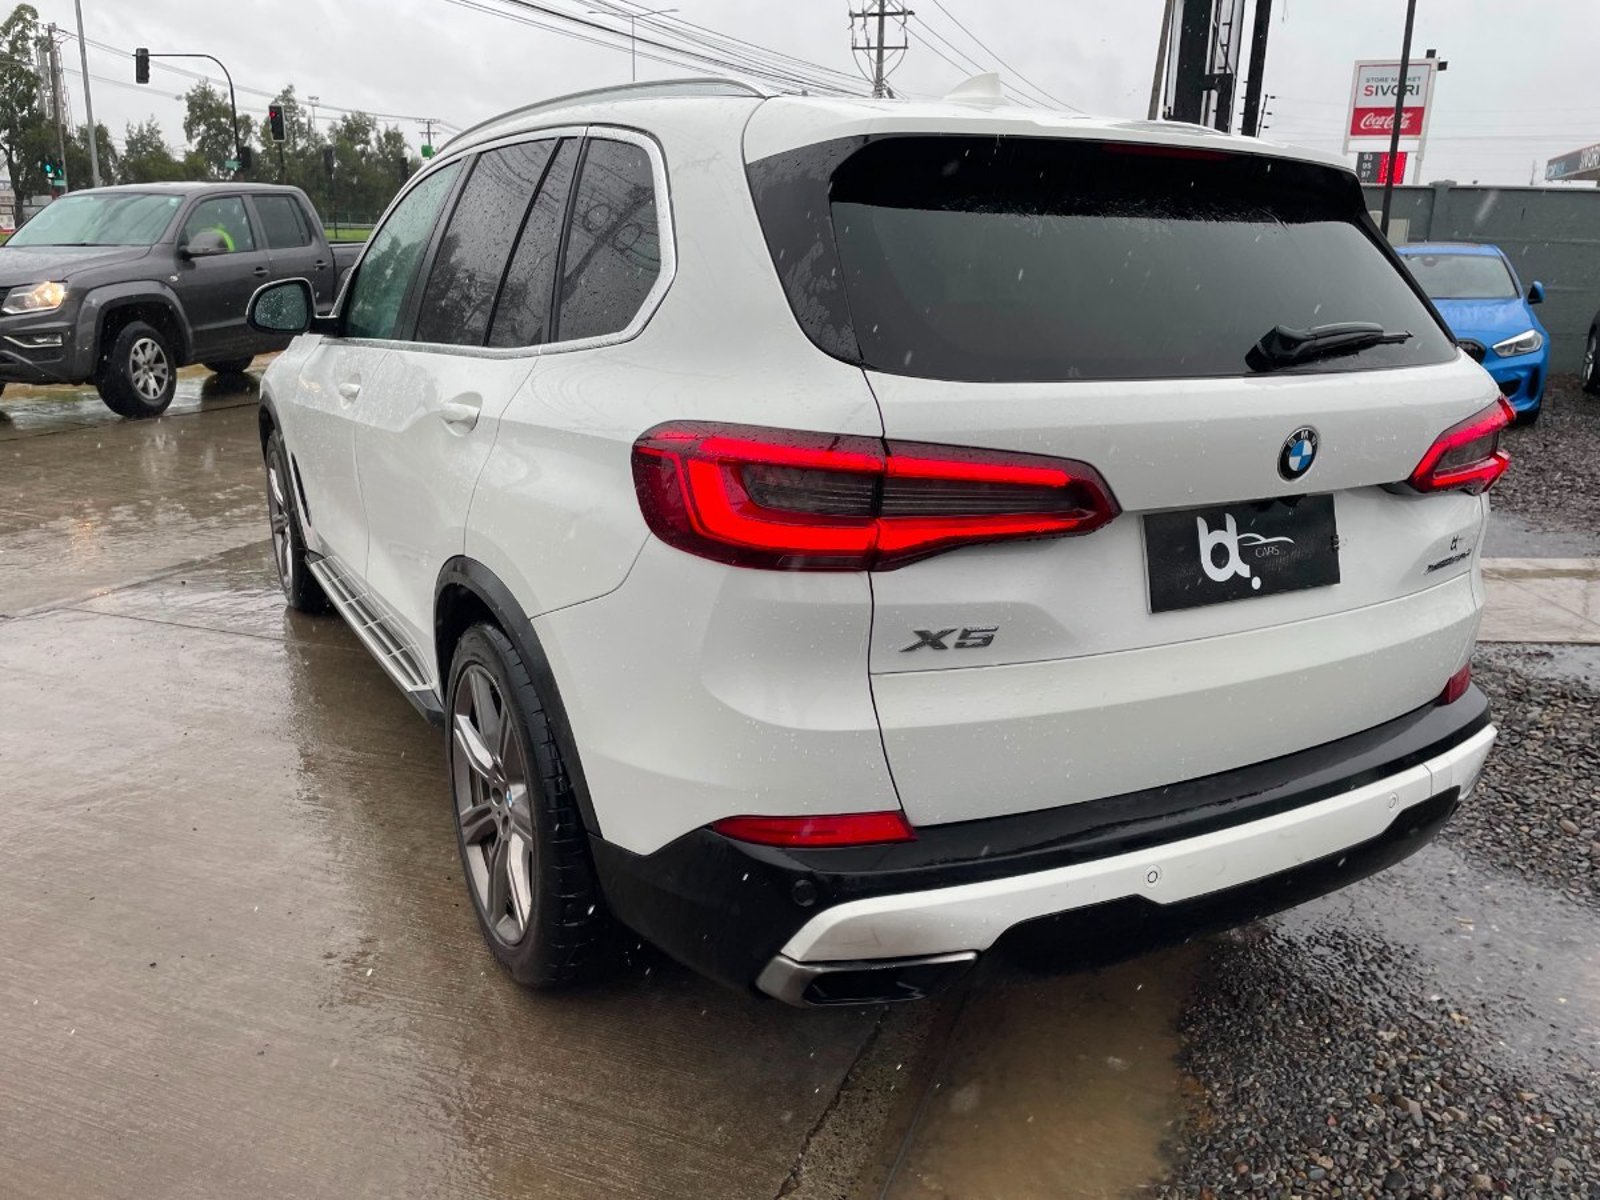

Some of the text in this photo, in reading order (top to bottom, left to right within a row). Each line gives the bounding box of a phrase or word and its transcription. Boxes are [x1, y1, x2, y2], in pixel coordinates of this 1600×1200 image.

[1363, 84, 1420, 97] SIVORI
[1360, 112, 1413, 130] Coca-Ca
[1255, 544, 1280, 558] CARS
[899, 626, 999, 652] X5
